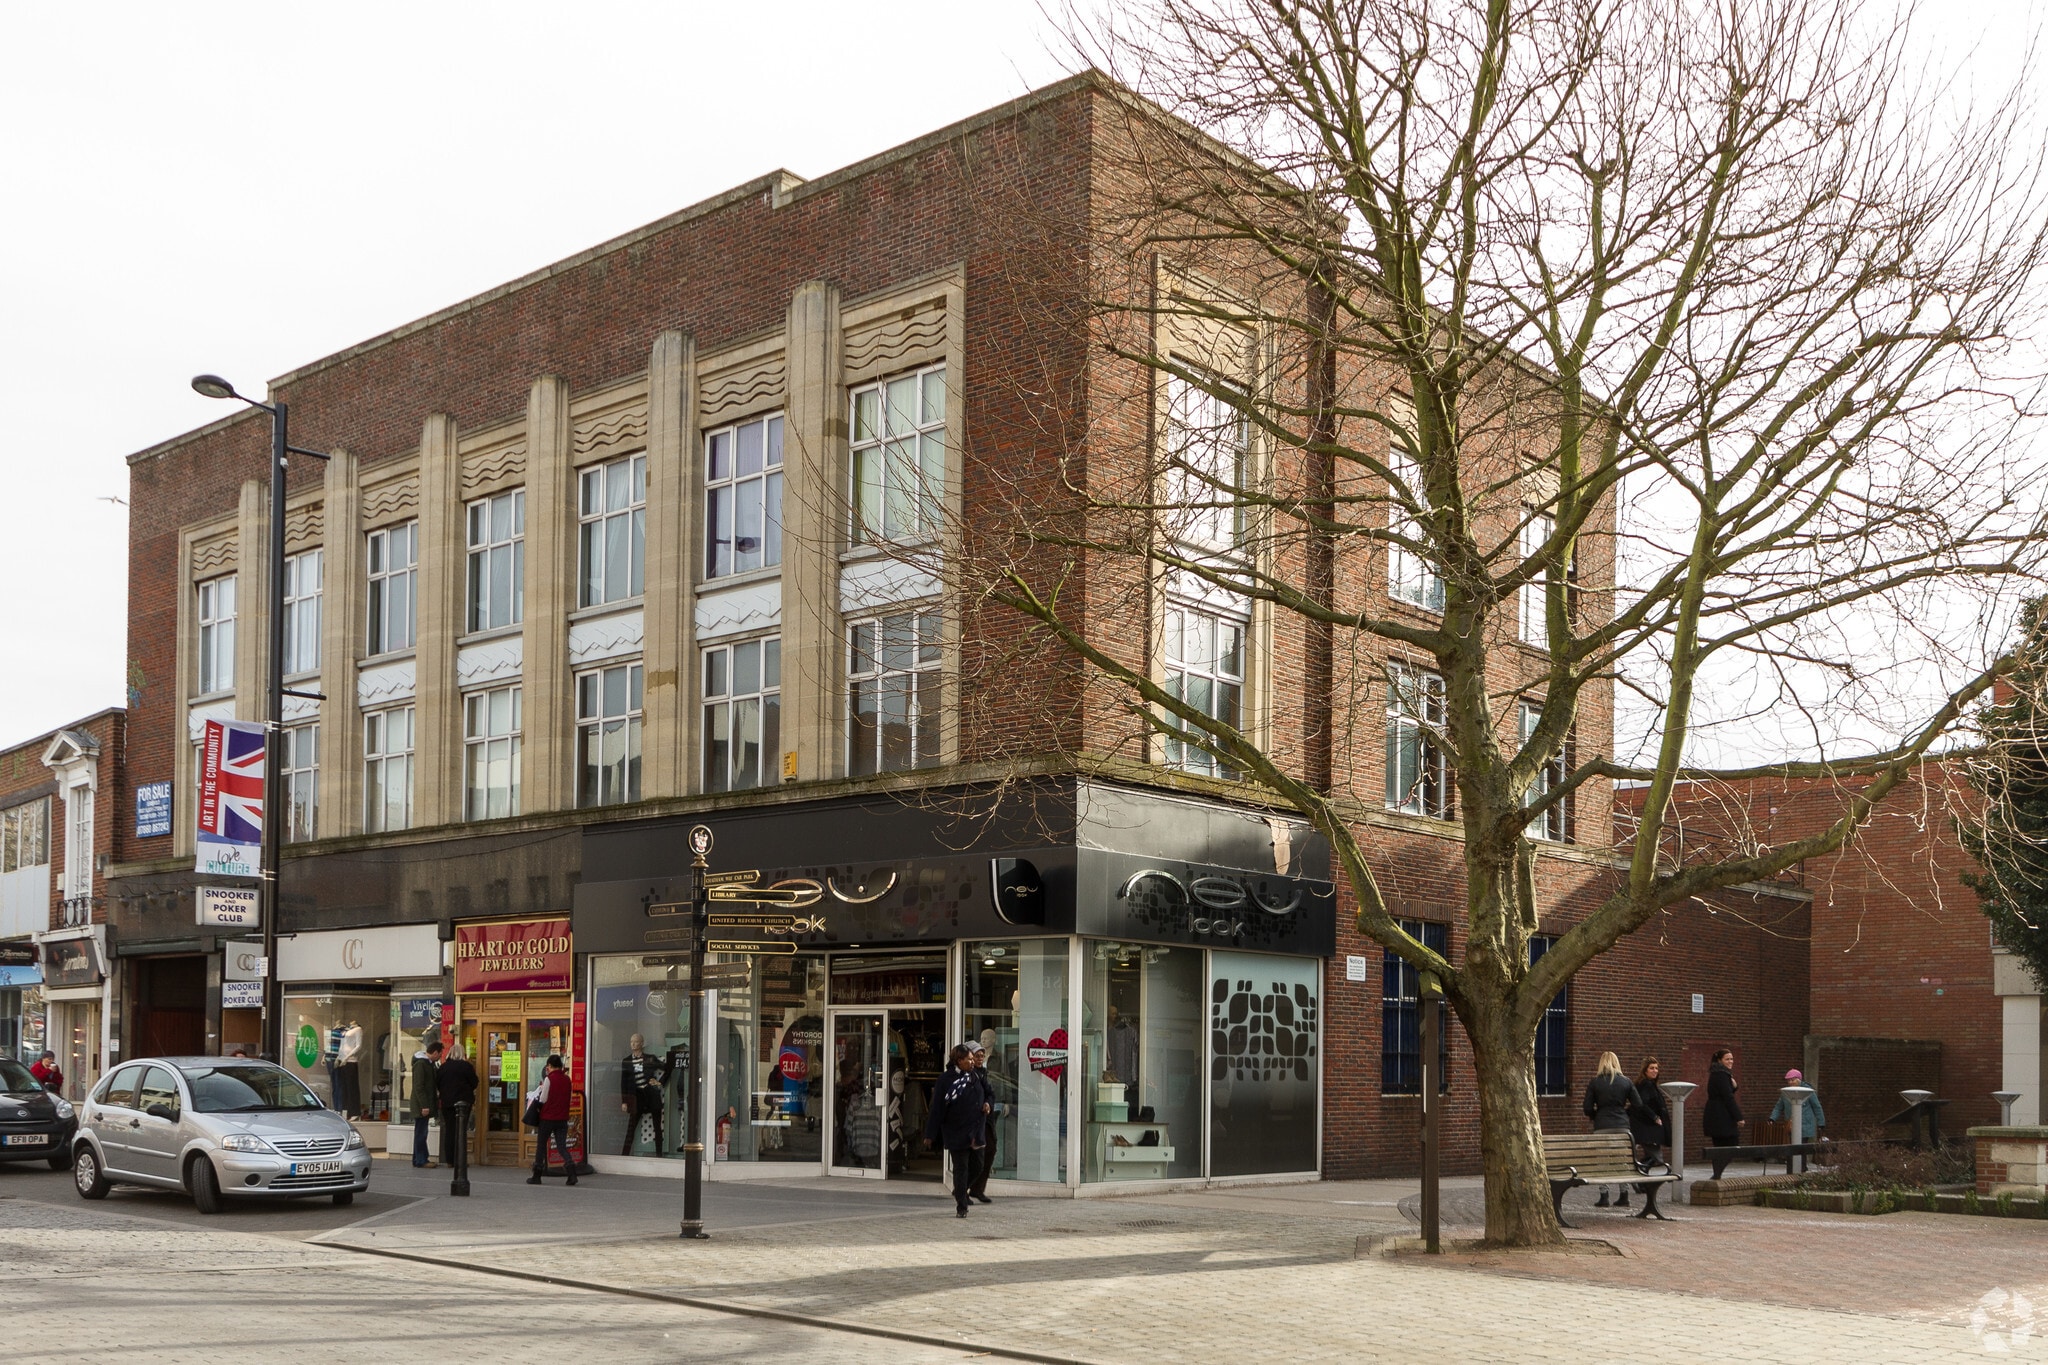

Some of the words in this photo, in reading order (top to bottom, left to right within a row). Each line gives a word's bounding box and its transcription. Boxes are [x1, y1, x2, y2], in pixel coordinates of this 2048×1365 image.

[206, 727, 220, 779] COMMUNITY
[138, 786, 152, 802] FOR
[152, 783, 170, 800] SALE
[205, 780, 217, 797] THE
[204, 798, 215, 808] IN
[203, 811, 214, 828] ART
[206, 859, 251, 875] CULTURE
[205, 889, 255, 900] SNOOKER
[213, 904, 246, 913] POKER
[217, 913, 243, 923] CLUB
[764, 917, 791, 925] CHURCH
[1188, 912, 1247, 938] look
[458, 940, 505, 958] HEART
[507, 941, 524, 956] OF
[527, 936, 569, 955] GOLD
[479, 957, 544, 972] JEWELLERS
[227, 982, 262, 992] SNOOKER
[223, 996, 246, 1004] POKER
[28, 1135, 44, 1143] OPA
[297, 1163, 321, 1173] EY05
[322, 1162, 340, 1172] UAH
